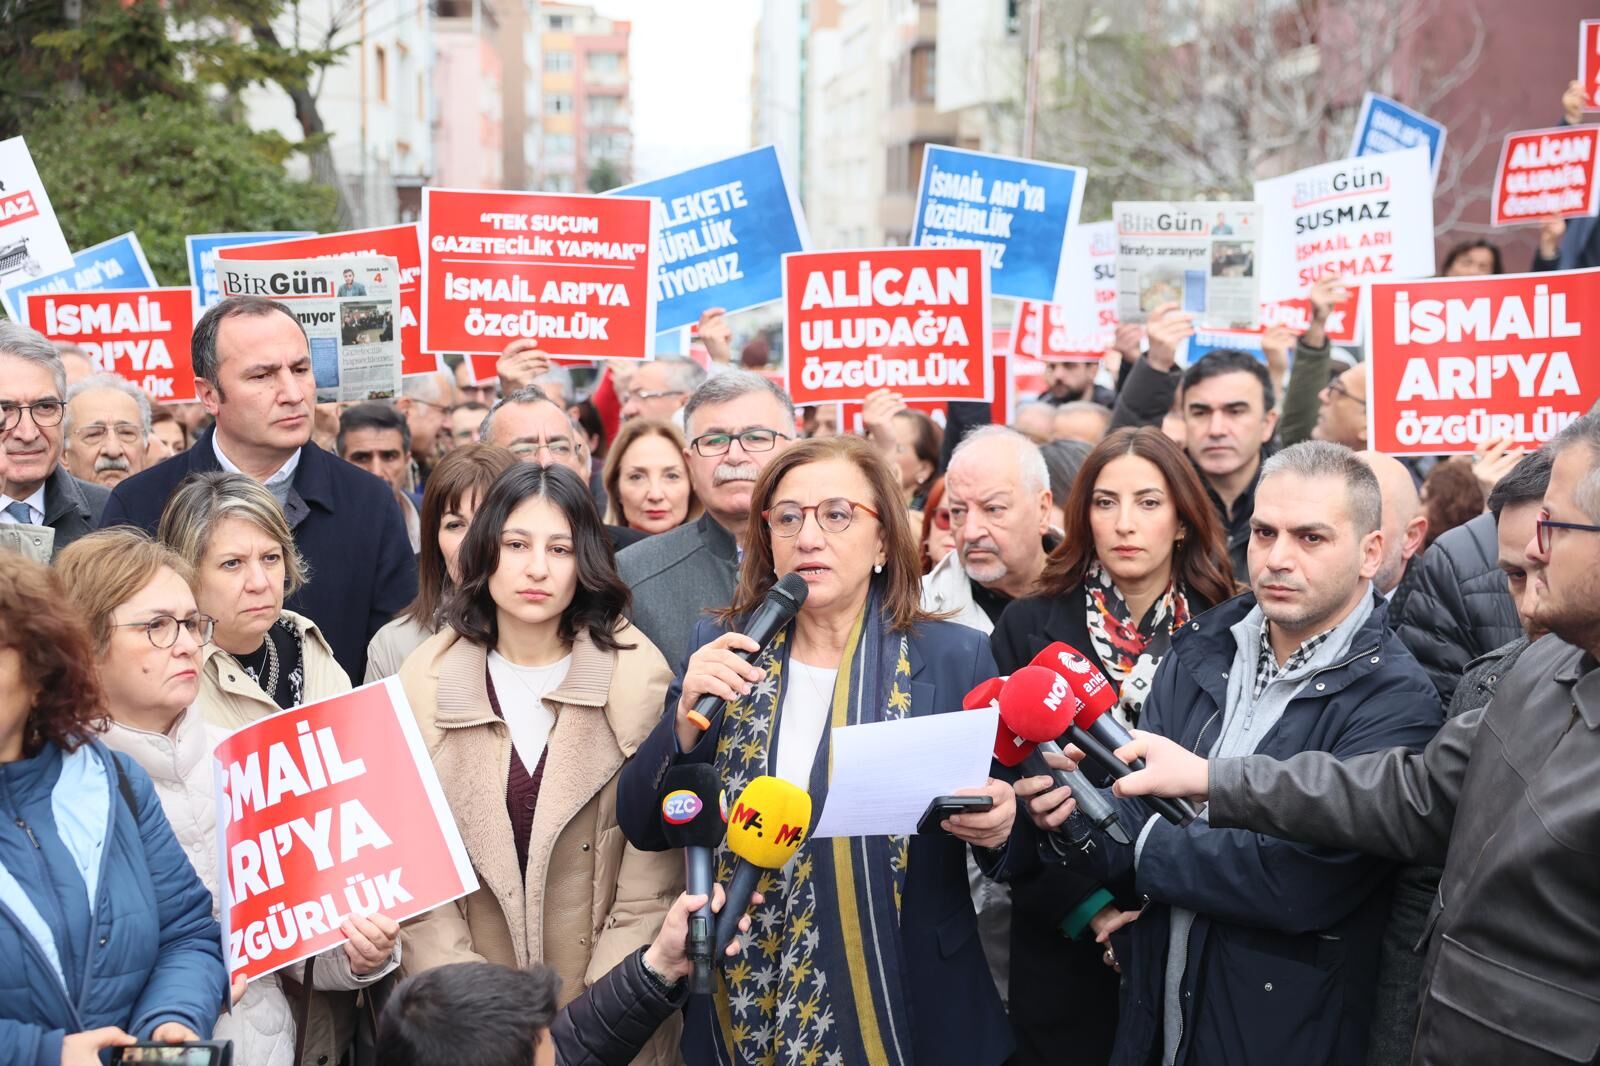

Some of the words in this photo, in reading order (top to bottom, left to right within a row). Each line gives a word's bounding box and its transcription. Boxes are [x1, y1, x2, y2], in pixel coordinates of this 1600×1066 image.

[928, 164, 987, 204] İSMAİL
[660, 180, 748, 229] LEKETE
[923, 198, 1014, 239] ÖZGÜRLÜK
[1295, 200, 1391, 235] SUSMAZ
[531, 214, 598, 235] SUÇUM
[431, 234, 553, 257] GAZETECİLİK
[374, 272, 383, 283] 4
[445, 272, 536, 302] İSMAİL
[800, 261, 969, 310] ALİCAN
[1299, 253, 1394, 287] SUSMAZ
[45, 295, 172, 336] İSMAİL
[297, 311, 336, 326] nıyor
[464, 308, 609, 341] ÖZGÜRLÜK
[1394, 284, 1582, 346] İSMAİL
[77, 338, 174, 372] RI'YA
[801, 353, 970, 390] ÖZGÜRLÜK
[665, 797, 697, 816] SZC
[226, 798, 394, 905] RI'YA
[229, 866, 414, 971] ZGÜRLÜK
